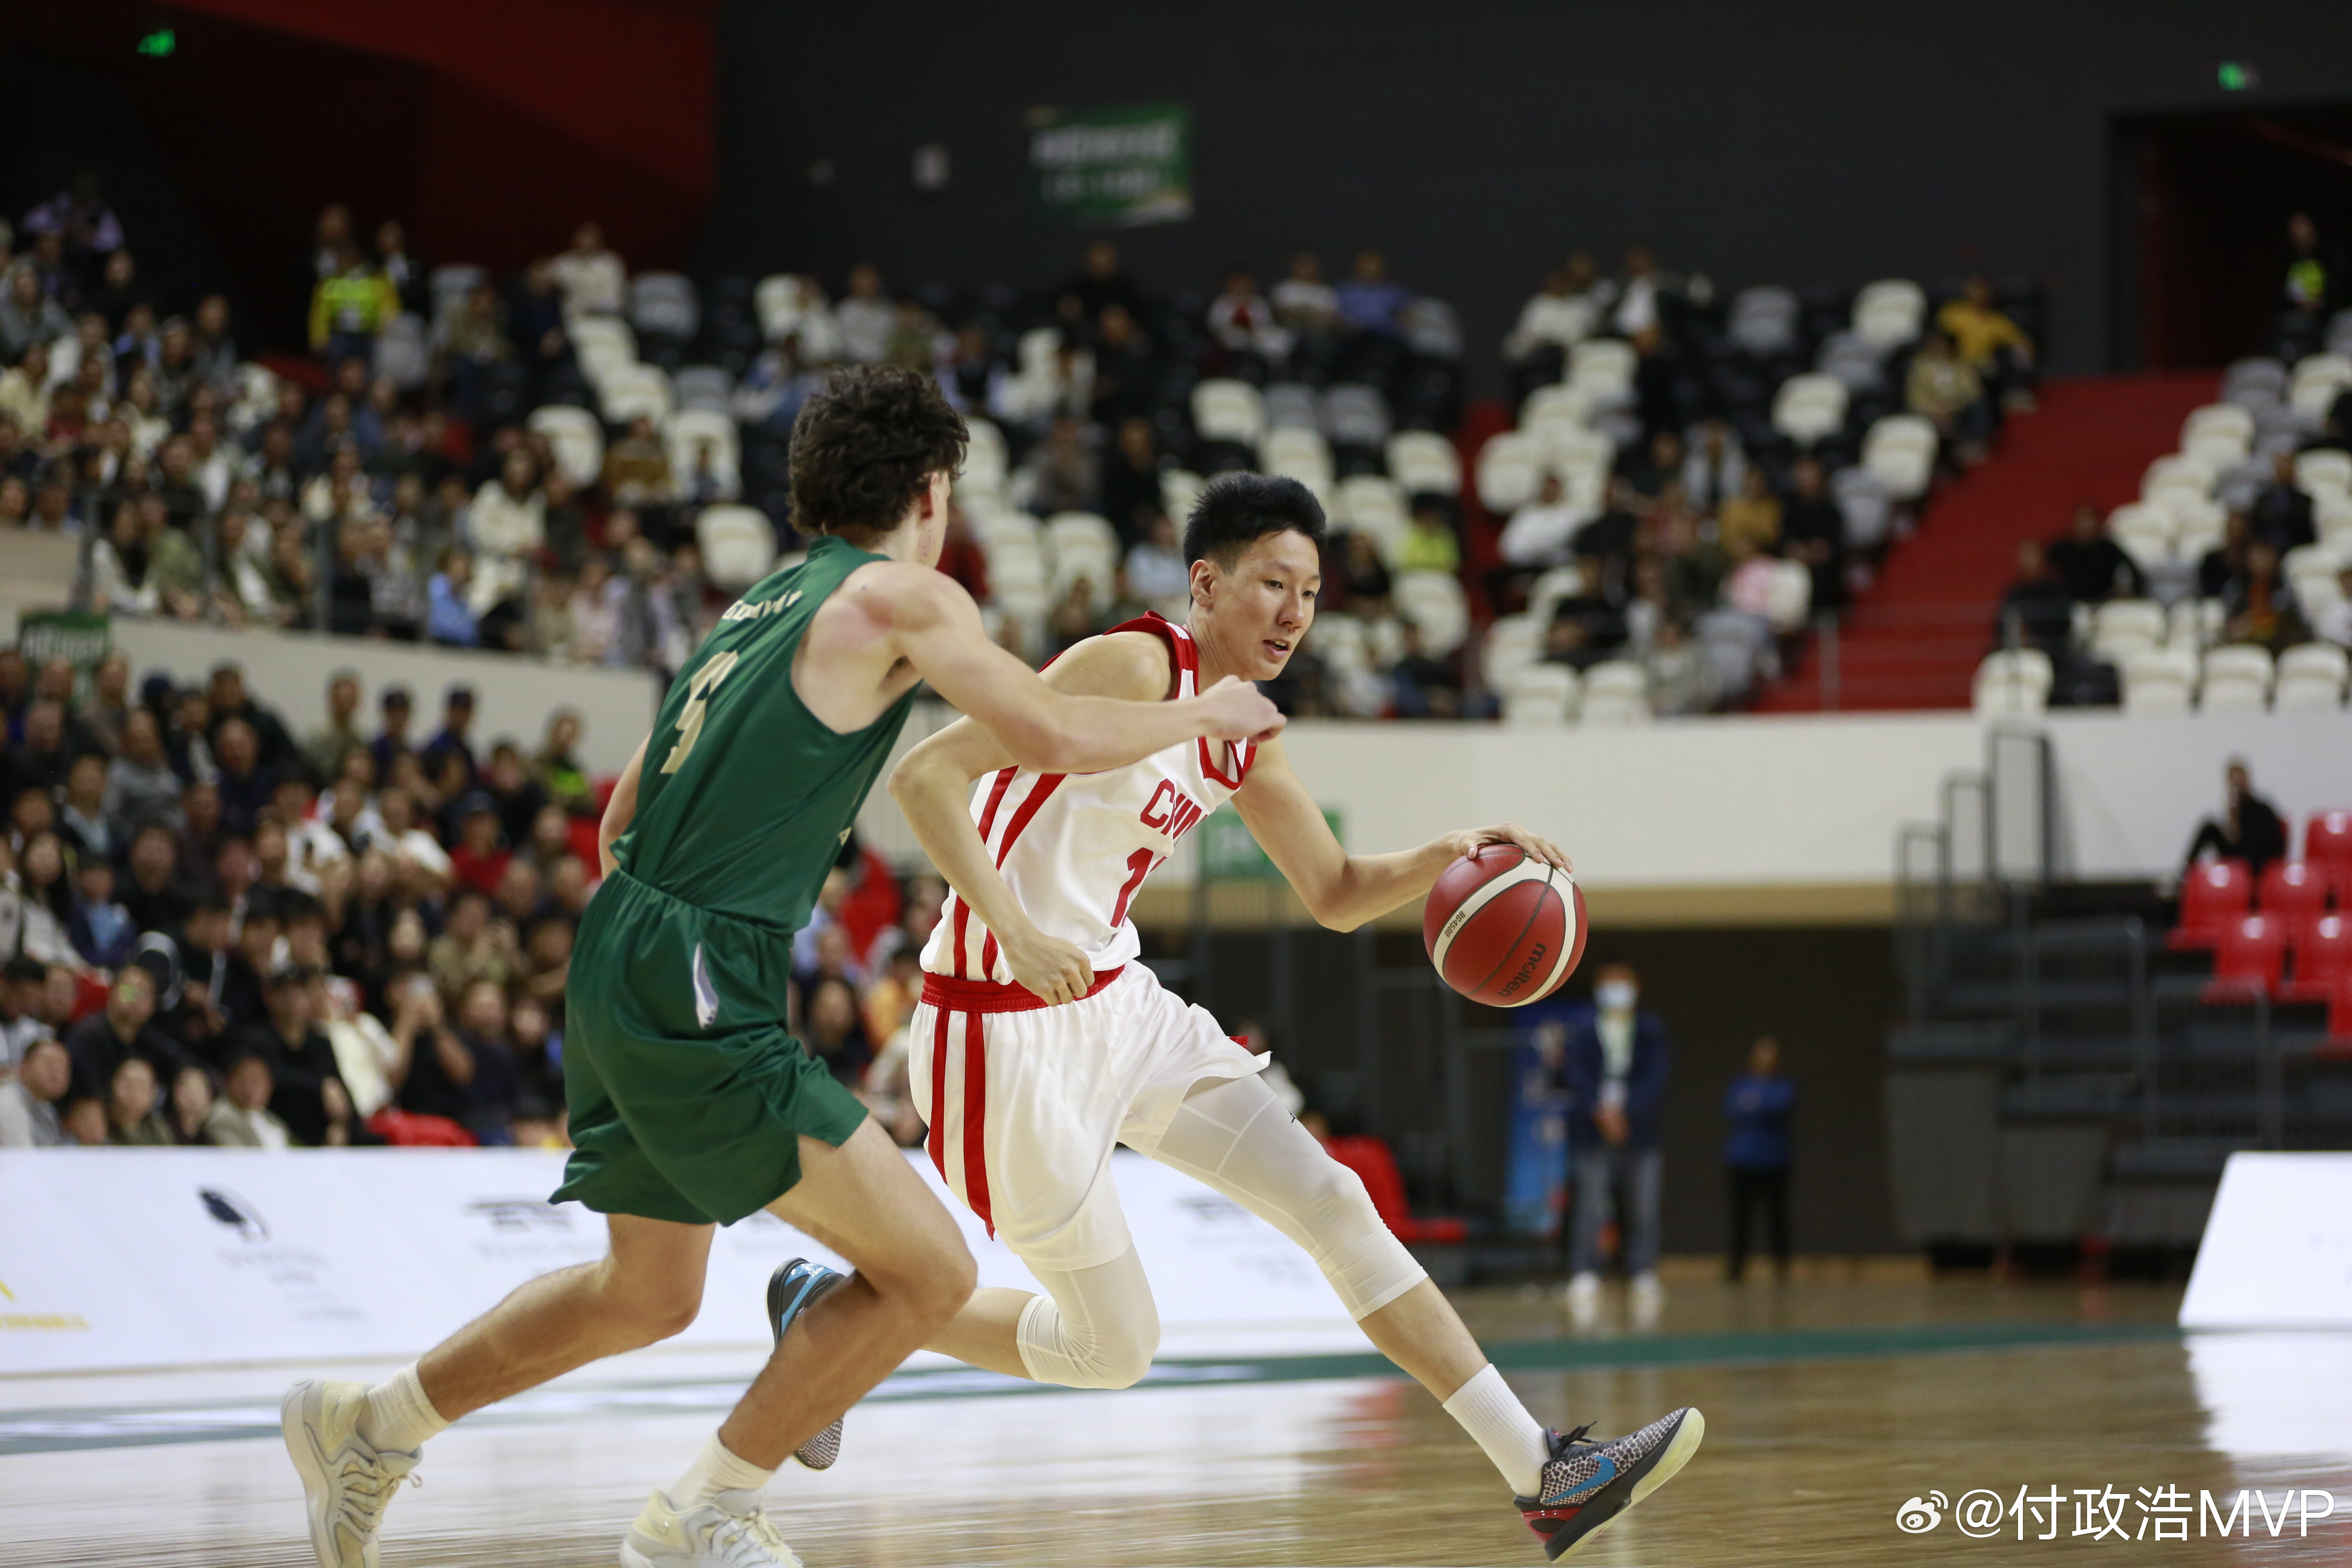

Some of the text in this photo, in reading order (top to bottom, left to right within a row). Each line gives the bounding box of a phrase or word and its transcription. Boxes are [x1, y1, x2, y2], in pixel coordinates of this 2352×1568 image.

[1110, 847, 1167, 928] 1
[1444, 910, 1466, 938] BG4500
[1497, 942, 1547, 997] molten
